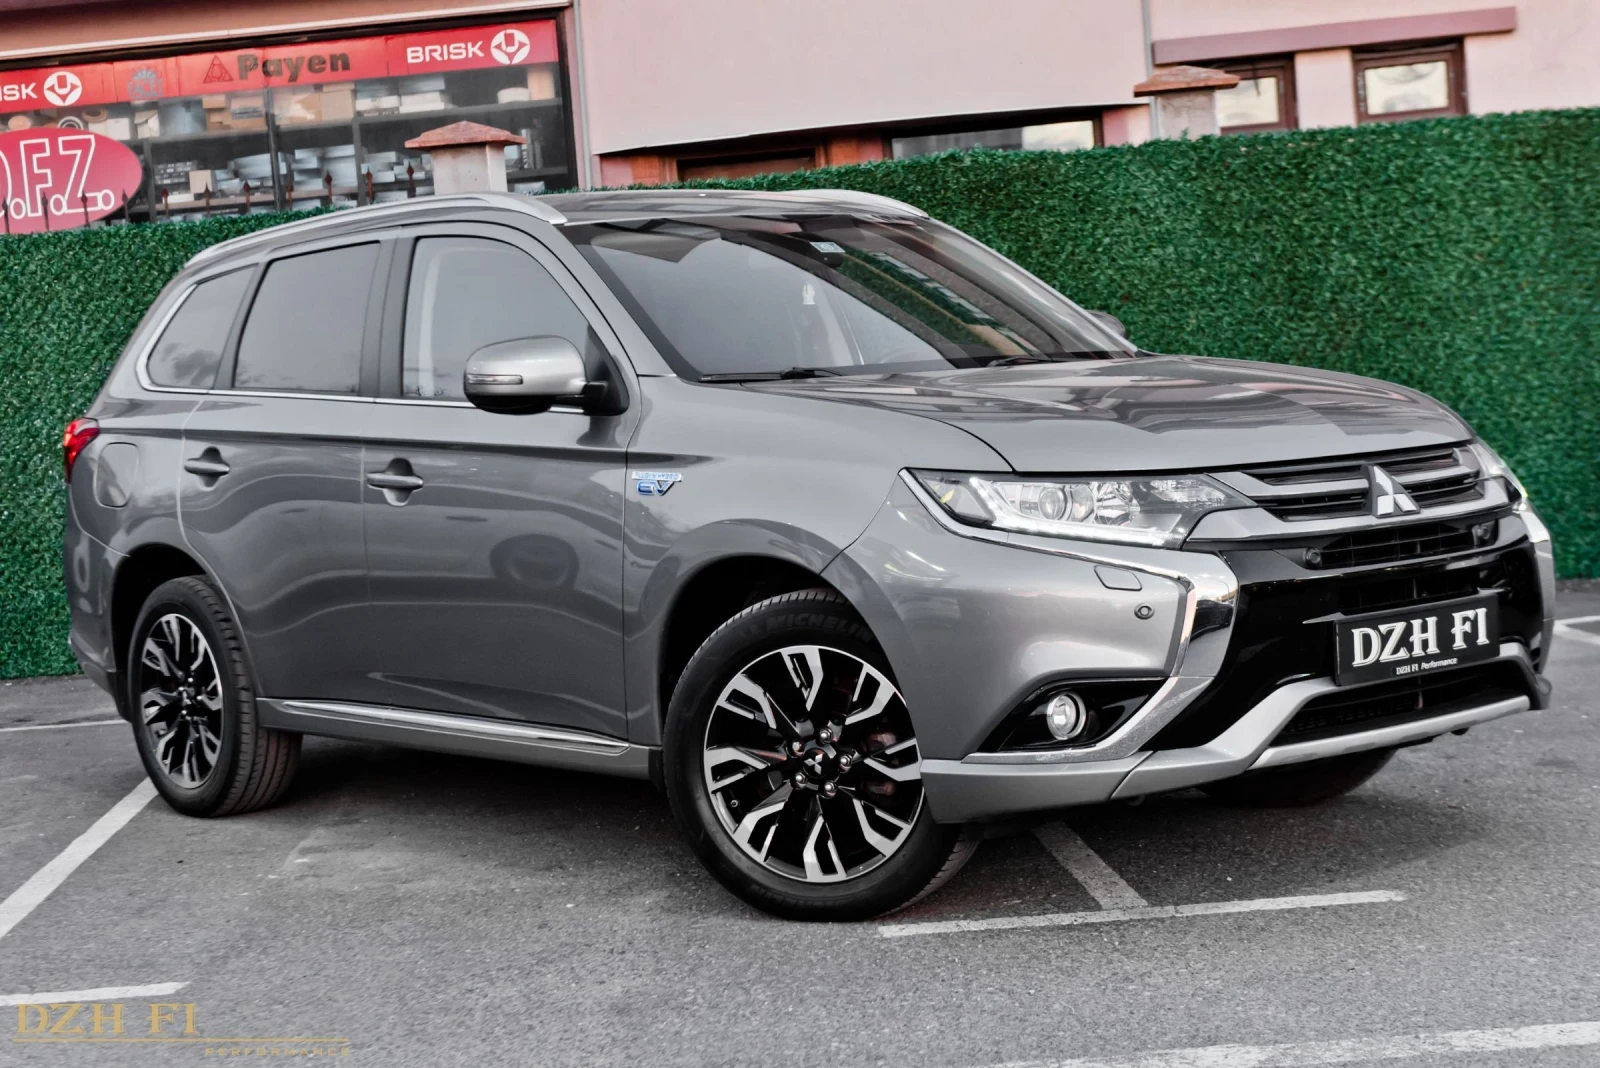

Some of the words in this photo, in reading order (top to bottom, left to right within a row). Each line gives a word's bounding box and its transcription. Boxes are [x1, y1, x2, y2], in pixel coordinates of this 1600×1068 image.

[406, 41, 484, 63] BRISK
[238, 52, 351, 83] Payen
[637, 480, 675, 496] EV
[766, 613, 874, 643] MICHELIN
[1351, 616, 1441, 667] DZH
[1395, 665, 1411, 675] DZH
[1420, 658, 1458, 670] Performance
